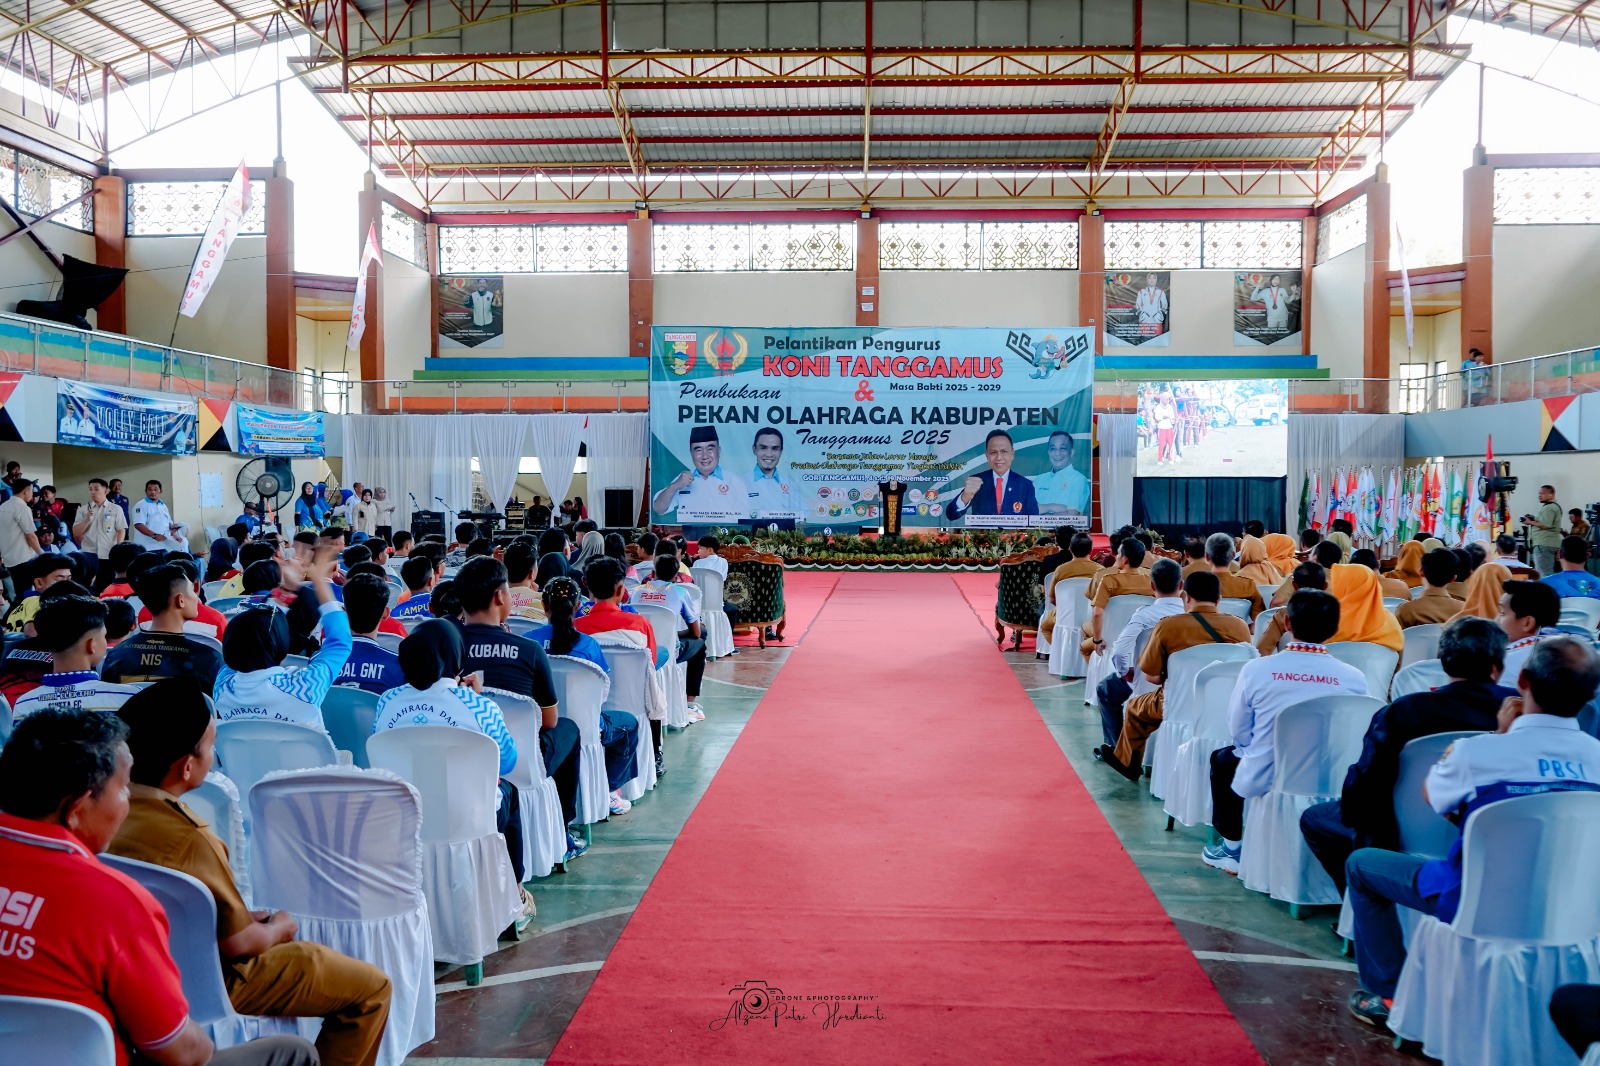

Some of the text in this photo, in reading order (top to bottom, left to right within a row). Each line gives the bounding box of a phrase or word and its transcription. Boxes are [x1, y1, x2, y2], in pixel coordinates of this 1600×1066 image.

[182, 218, 230, 310] TANGGAMUS
[764, 336, 940, 352] Pelantikan Pengurus
[762, 355, 1004, 379] KONI TANGGAMUS
[680, 382, 781, 399] Pembukaan
[854, 380, 874, 402] &
[890, 382, 914, 391] Masa
[916, 382, 942, 391] Bakti
[978, 384, 1001, 392] 2029
[678, 405, 1059, 426] PEKAN OLAHRAGA KABUPATEN
[796, 429, 952, 449] Tanggamus 2025
[140, 654, 162, 666] NIS
[360, 663, 385, 679] GNT
[1272, 673, 1339, 686] TANGGAMUS
[74, 700, 82, 708] FC
[275, 713, 295, 722] DA
[388, 704, 434, 729] OLAHRAGA
[1538, 758, 1587, 780] PBSI
